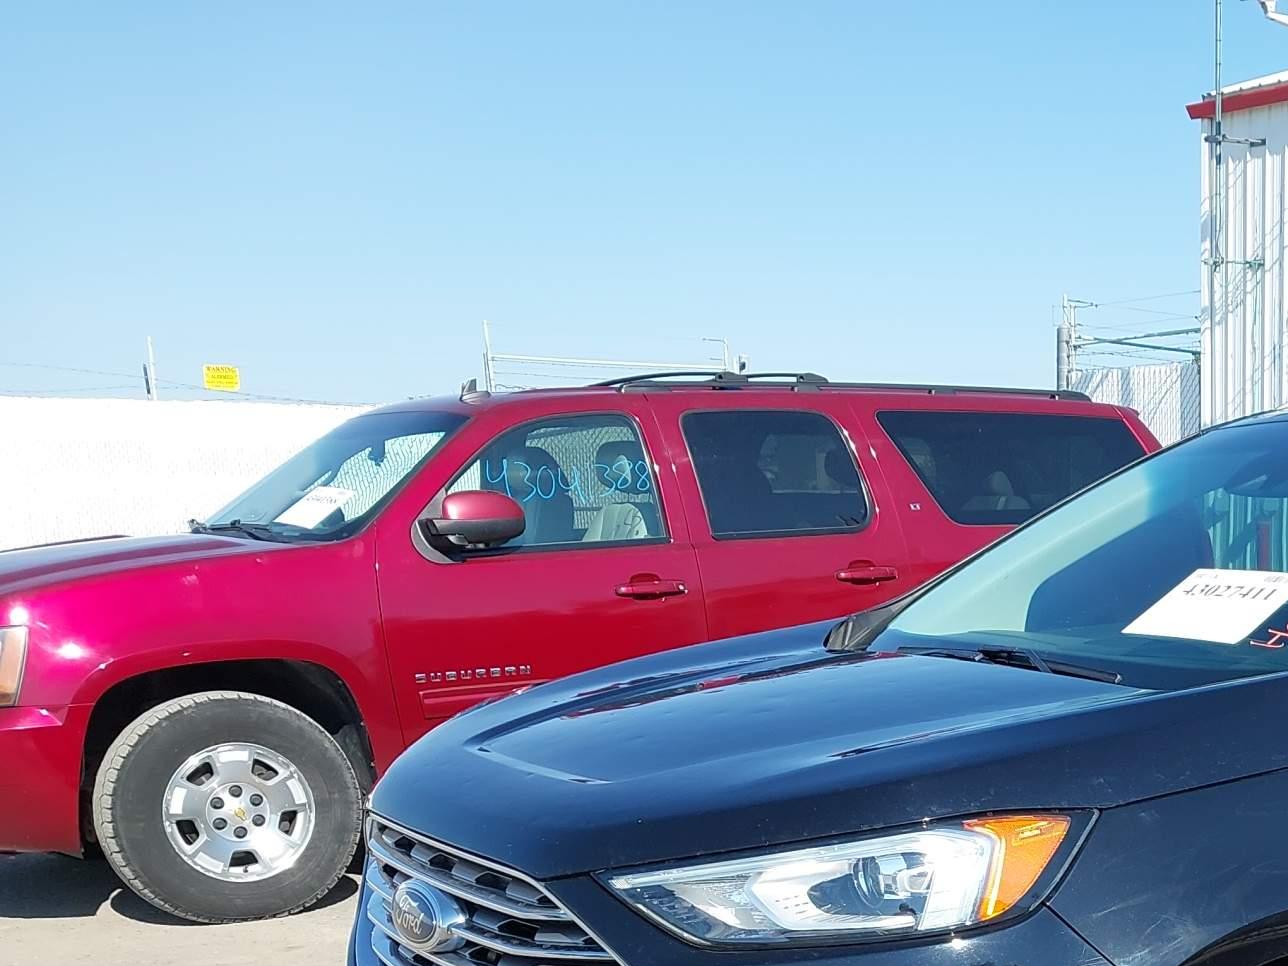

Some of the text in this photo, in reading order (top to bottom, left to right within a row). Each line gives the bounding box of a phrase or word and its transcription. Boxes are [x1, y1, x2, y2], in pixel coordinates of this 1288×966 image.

[1182, 583, 1278, 601] 43027411
[414, 664, 531, 684] SUBURBAN
[396, 894, 425, 935] Ford
